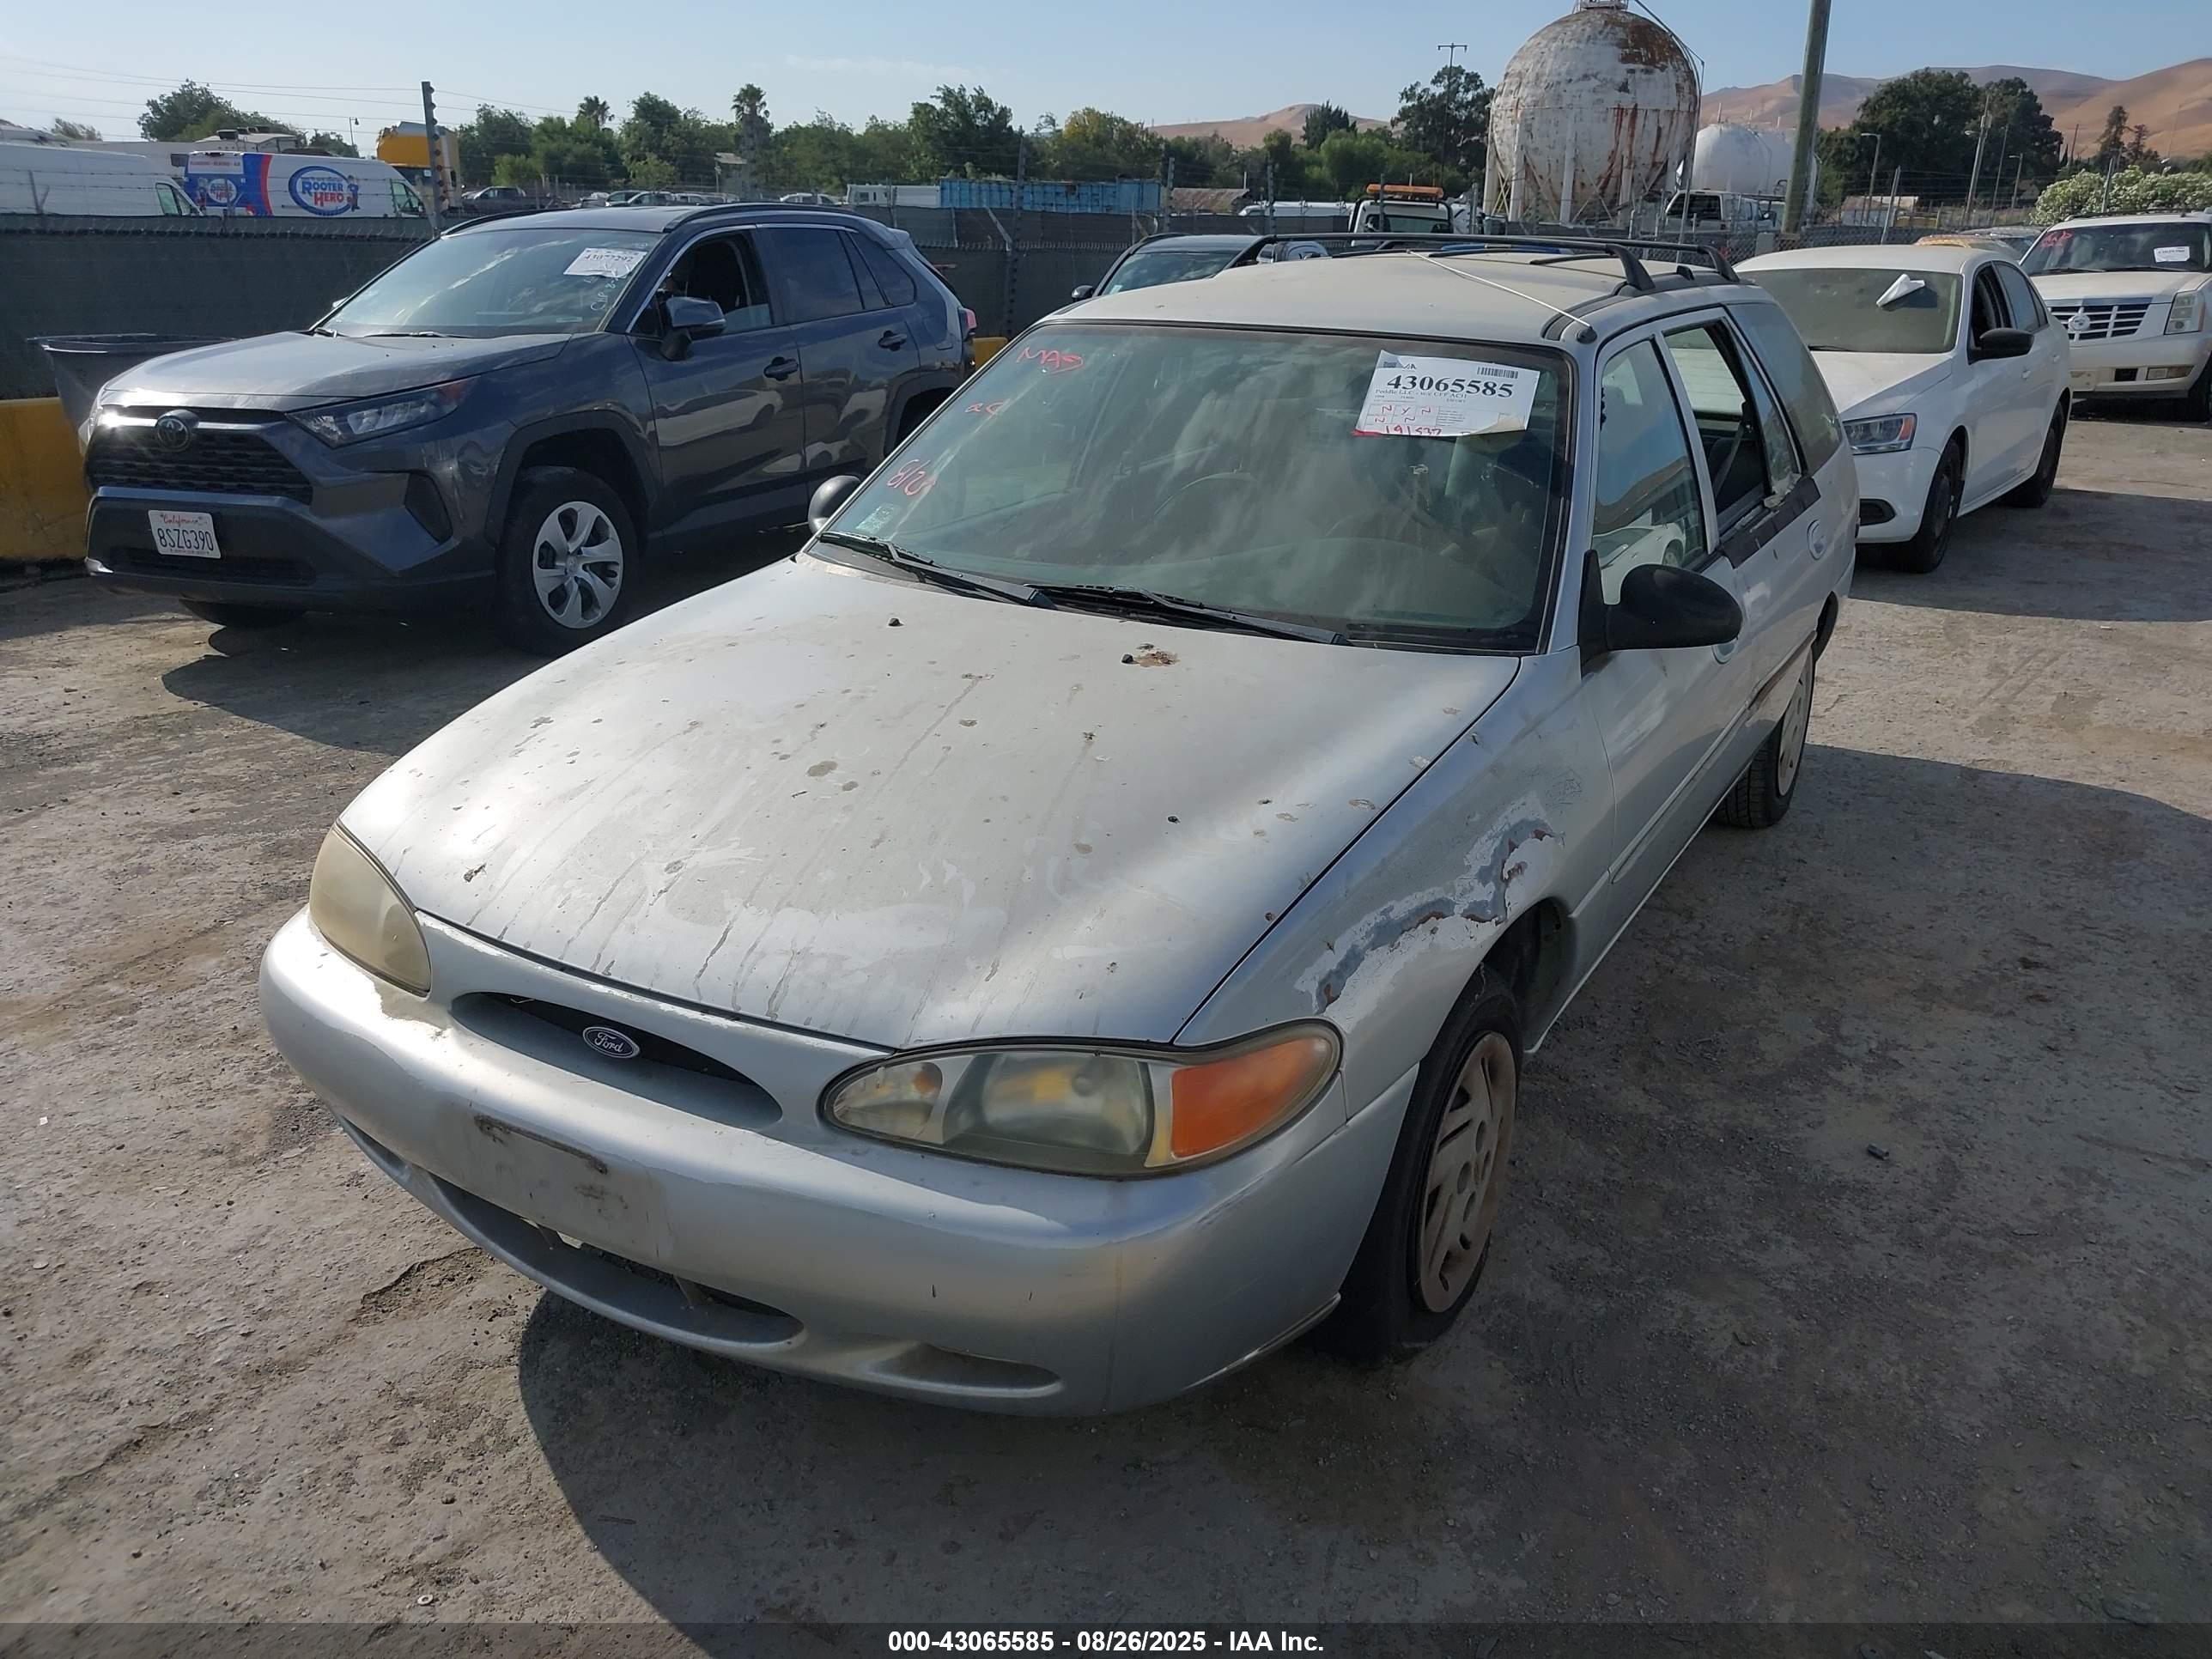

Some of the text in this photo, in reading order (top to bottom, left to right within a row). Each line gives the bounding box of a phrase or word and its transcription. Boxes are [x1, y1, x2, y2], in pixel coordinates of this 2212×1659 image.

[301, 181, 343, 197] ROOTER
[313, 192, 344, 207] HERO
[1387, 374, 1514, 398] 43065585
[157, 528, 214, 551] 8SZG390
[594, 1032, 624, 1053] Ford
